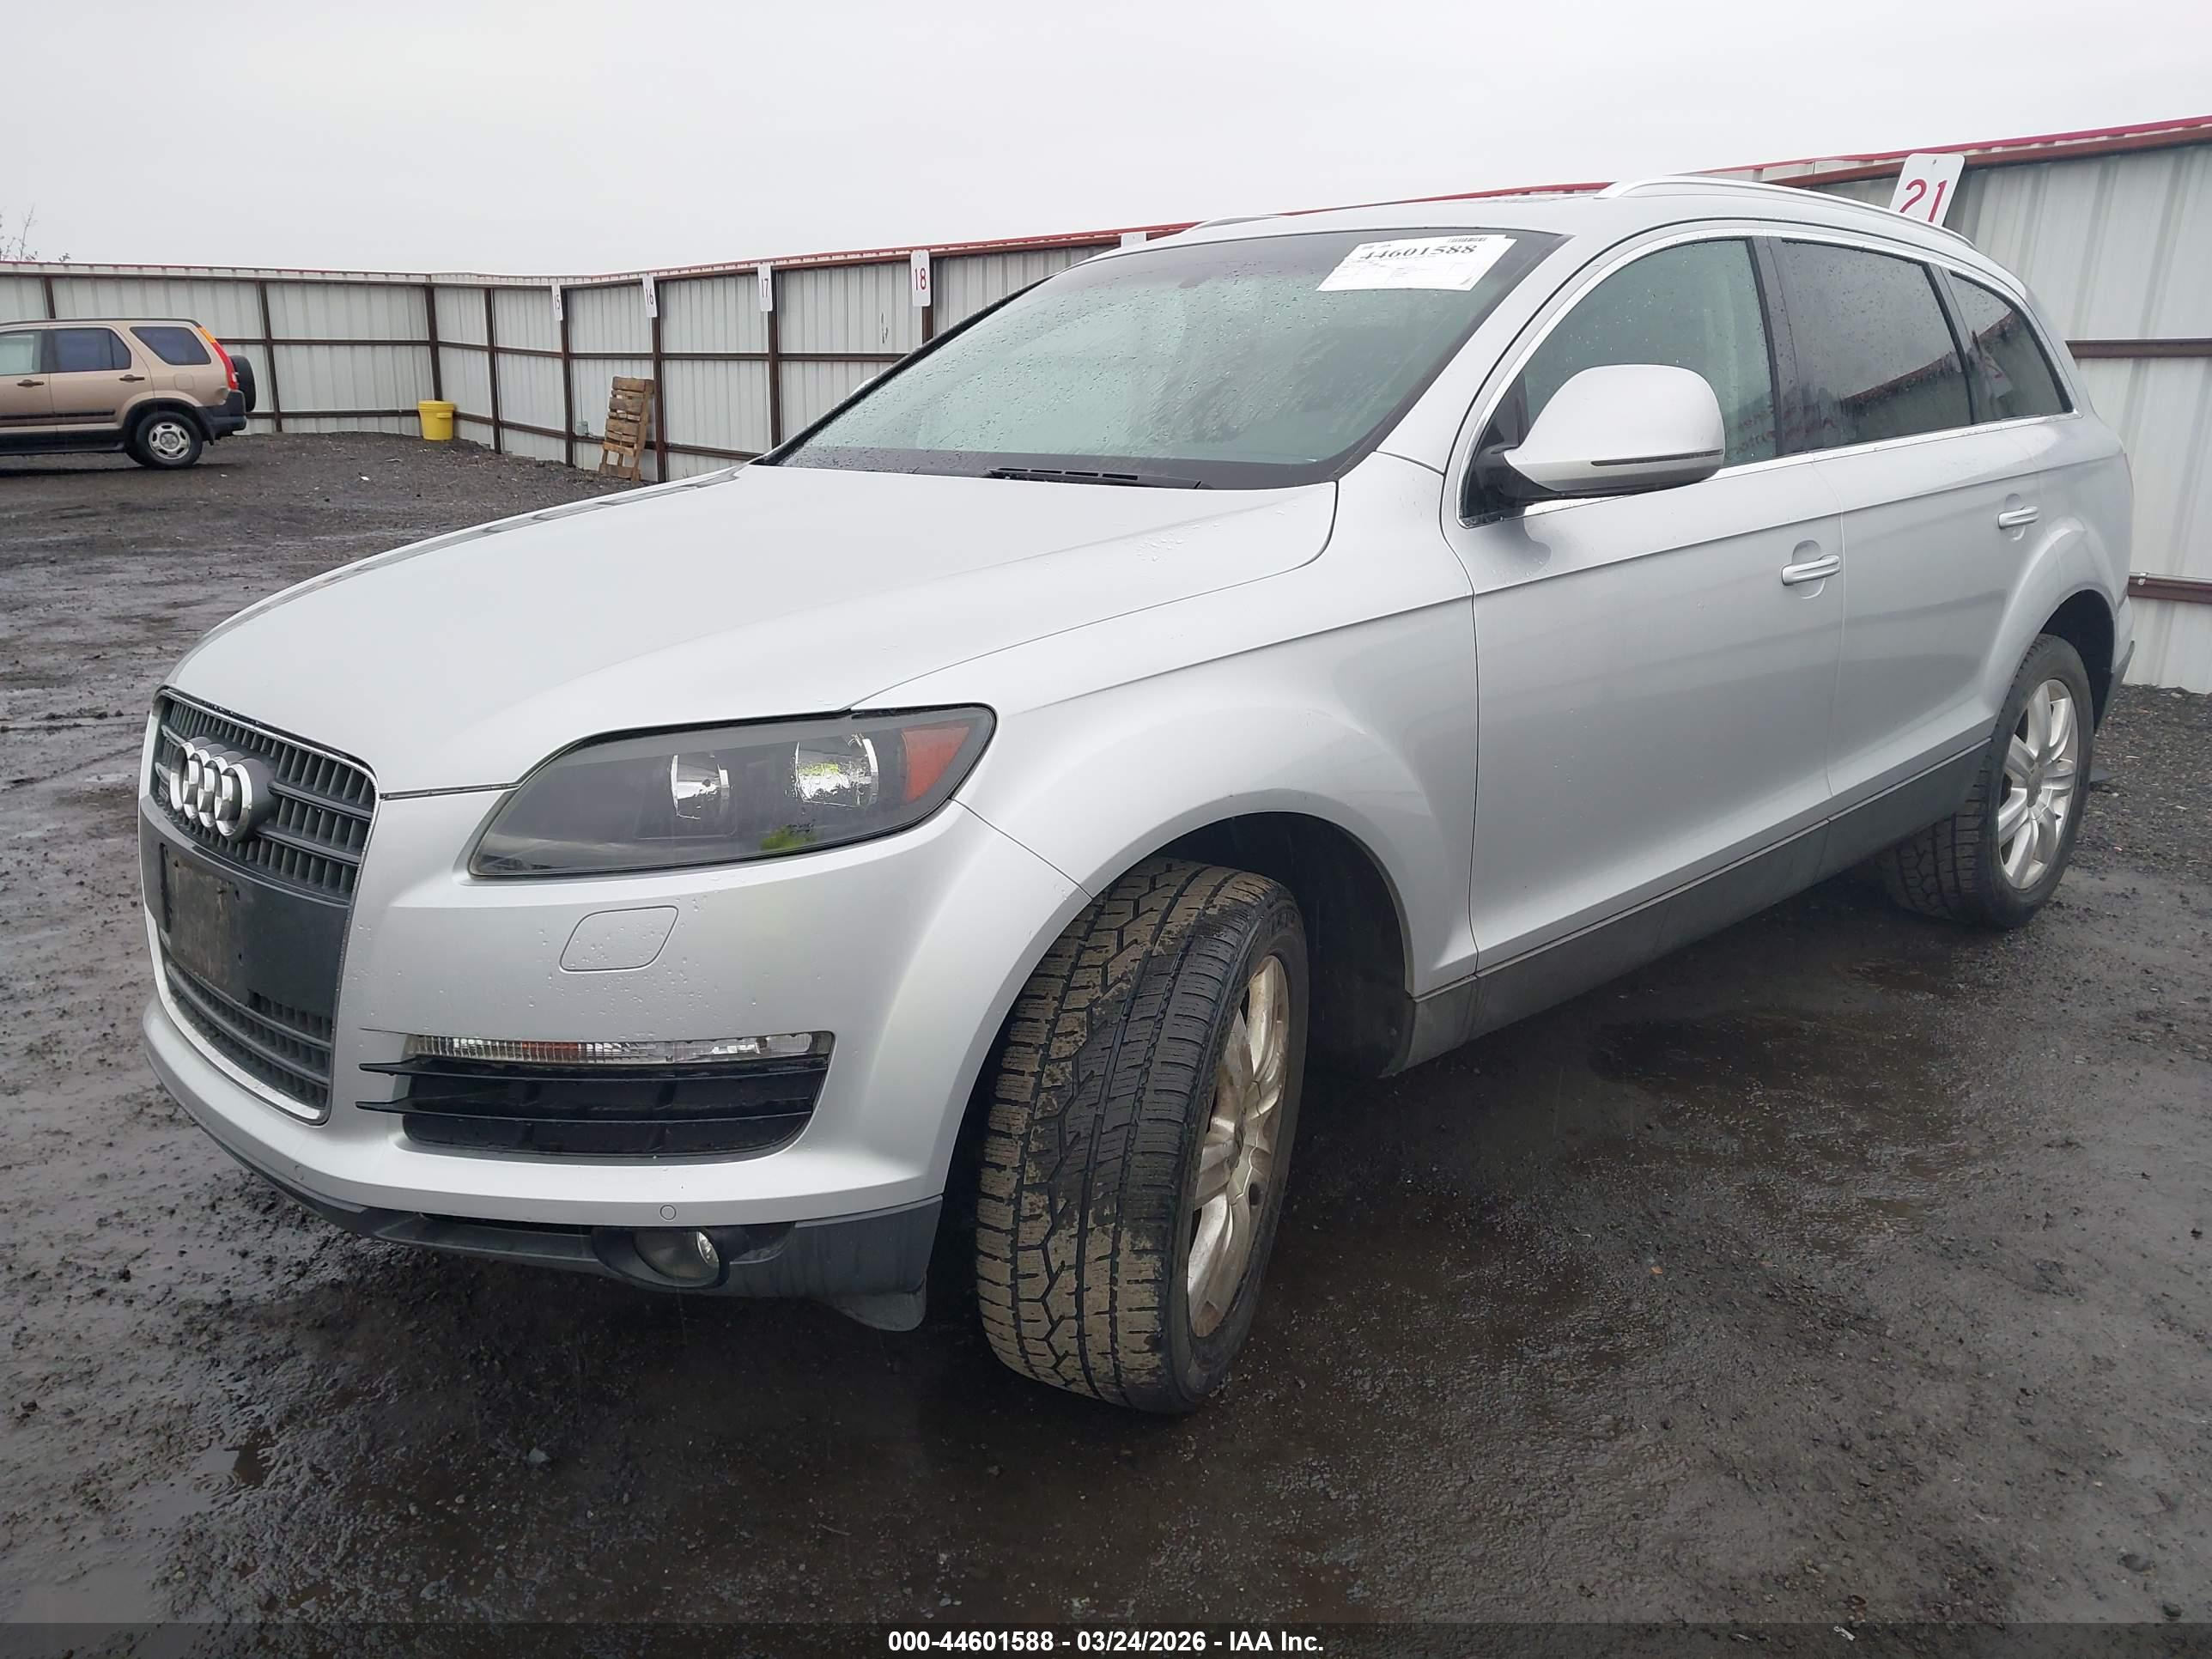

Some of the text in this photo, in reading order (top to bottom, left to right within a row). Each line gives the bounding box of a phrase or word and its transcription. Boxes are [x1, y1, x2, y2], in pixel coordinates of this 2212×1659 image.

[1899, 179, 1948, 222] 21
[1360, 244, 1478, 259] 44601588
[761, 277, 769, 298] 17
[915, 267, 927, 290] 18
[554, 294, 561, 311] 15
[645, 288, 654, 305] 16
